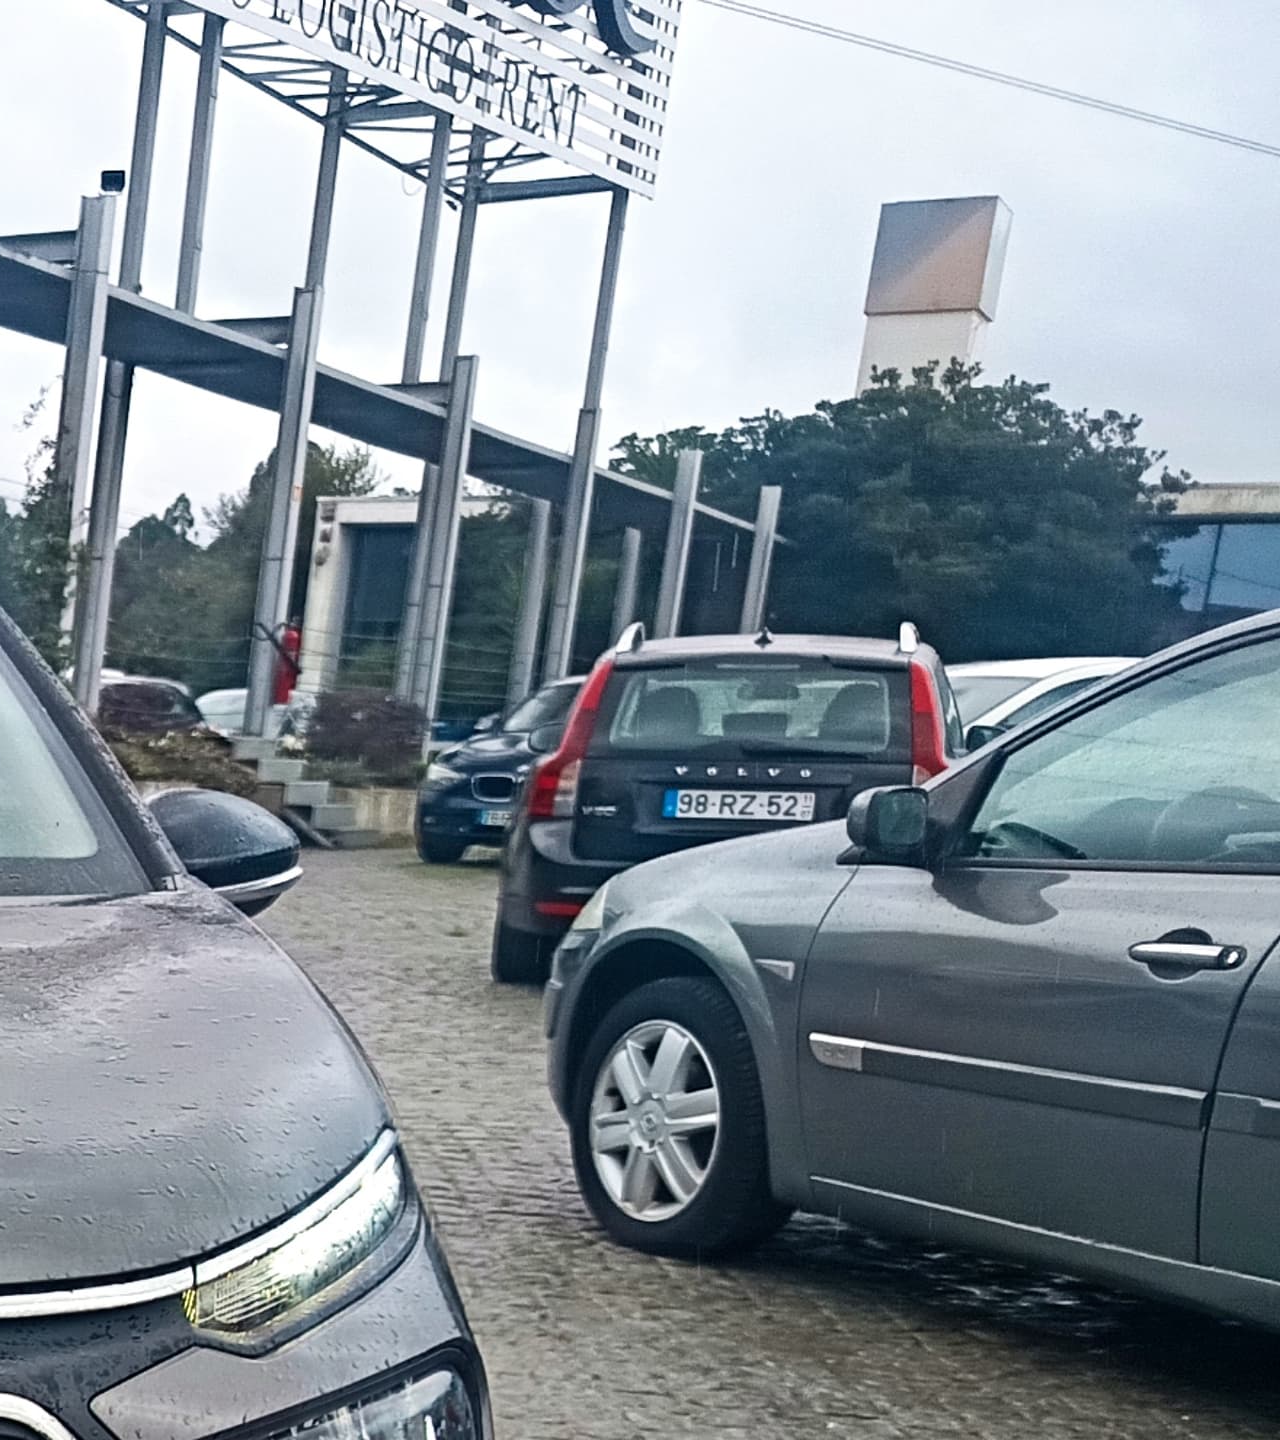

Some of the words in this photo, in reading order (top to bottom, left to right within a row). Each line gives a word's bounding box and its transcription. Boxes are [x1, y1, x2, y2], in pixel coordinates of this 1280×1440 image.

[497, 57, 587, 150] RENT
[674, 765, 812, 778] VOLVO
[678, 793, 799, 818] 98-RZ-52
